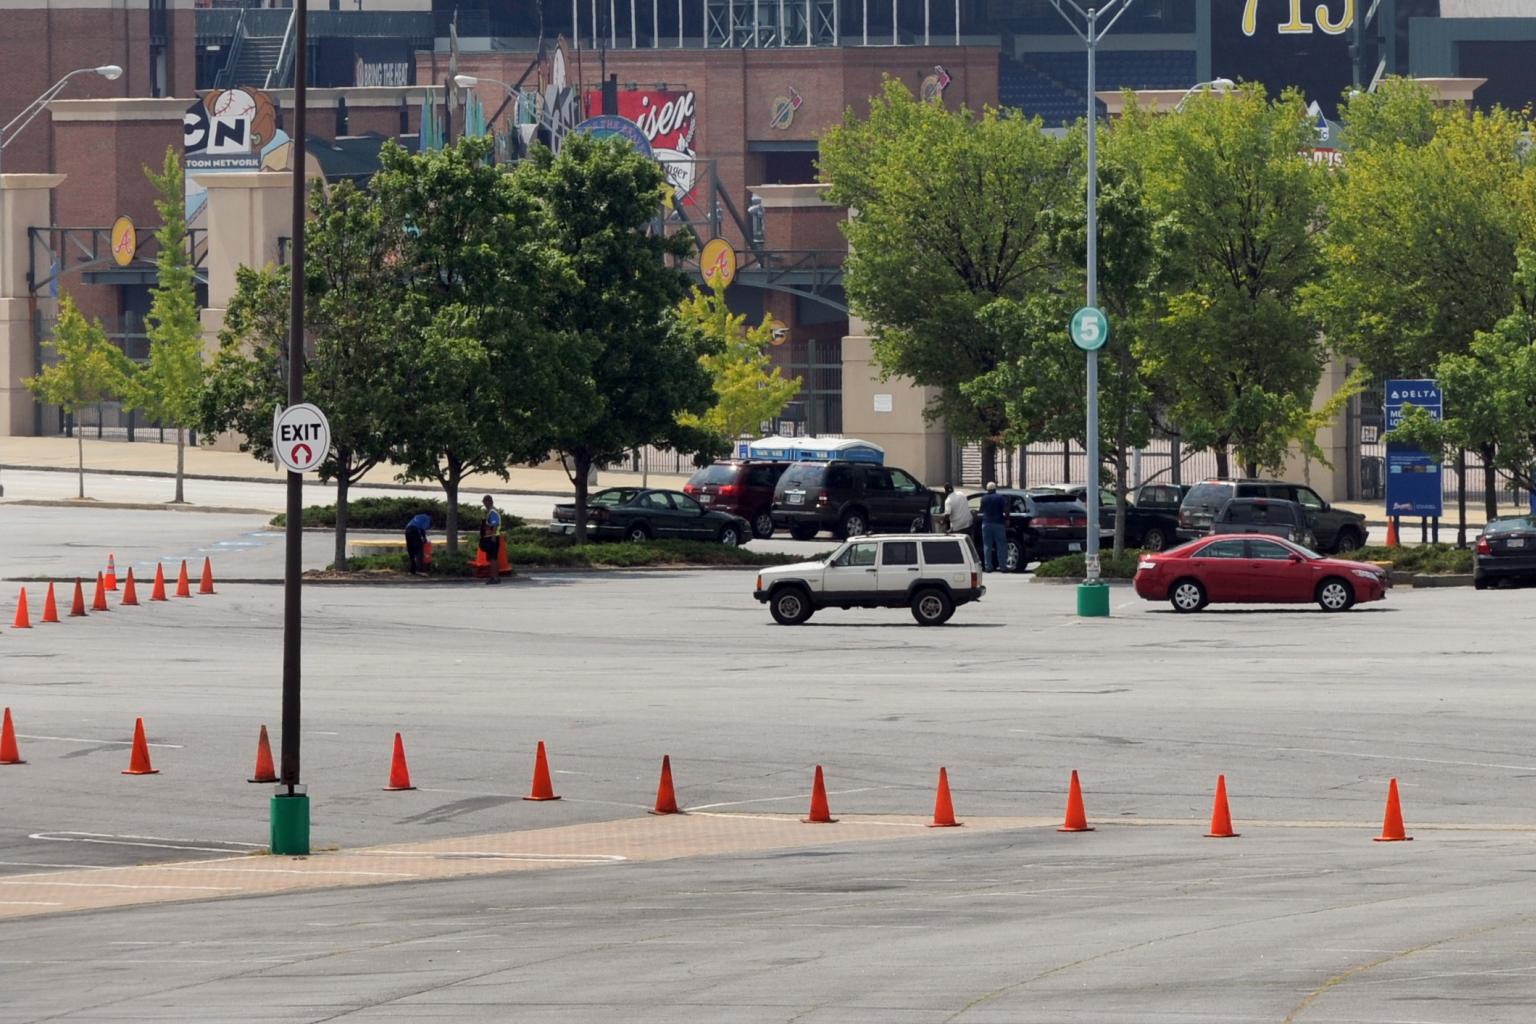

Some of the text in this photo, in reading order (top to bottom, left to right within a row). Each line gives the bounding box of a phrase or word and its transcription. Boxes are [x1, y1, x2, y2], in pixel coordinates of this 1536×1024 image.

[213, 159, 258, 167] NETWORK
[1080, 316, 1099, 340] 5
[281, 423, 321, 442] EXIT
